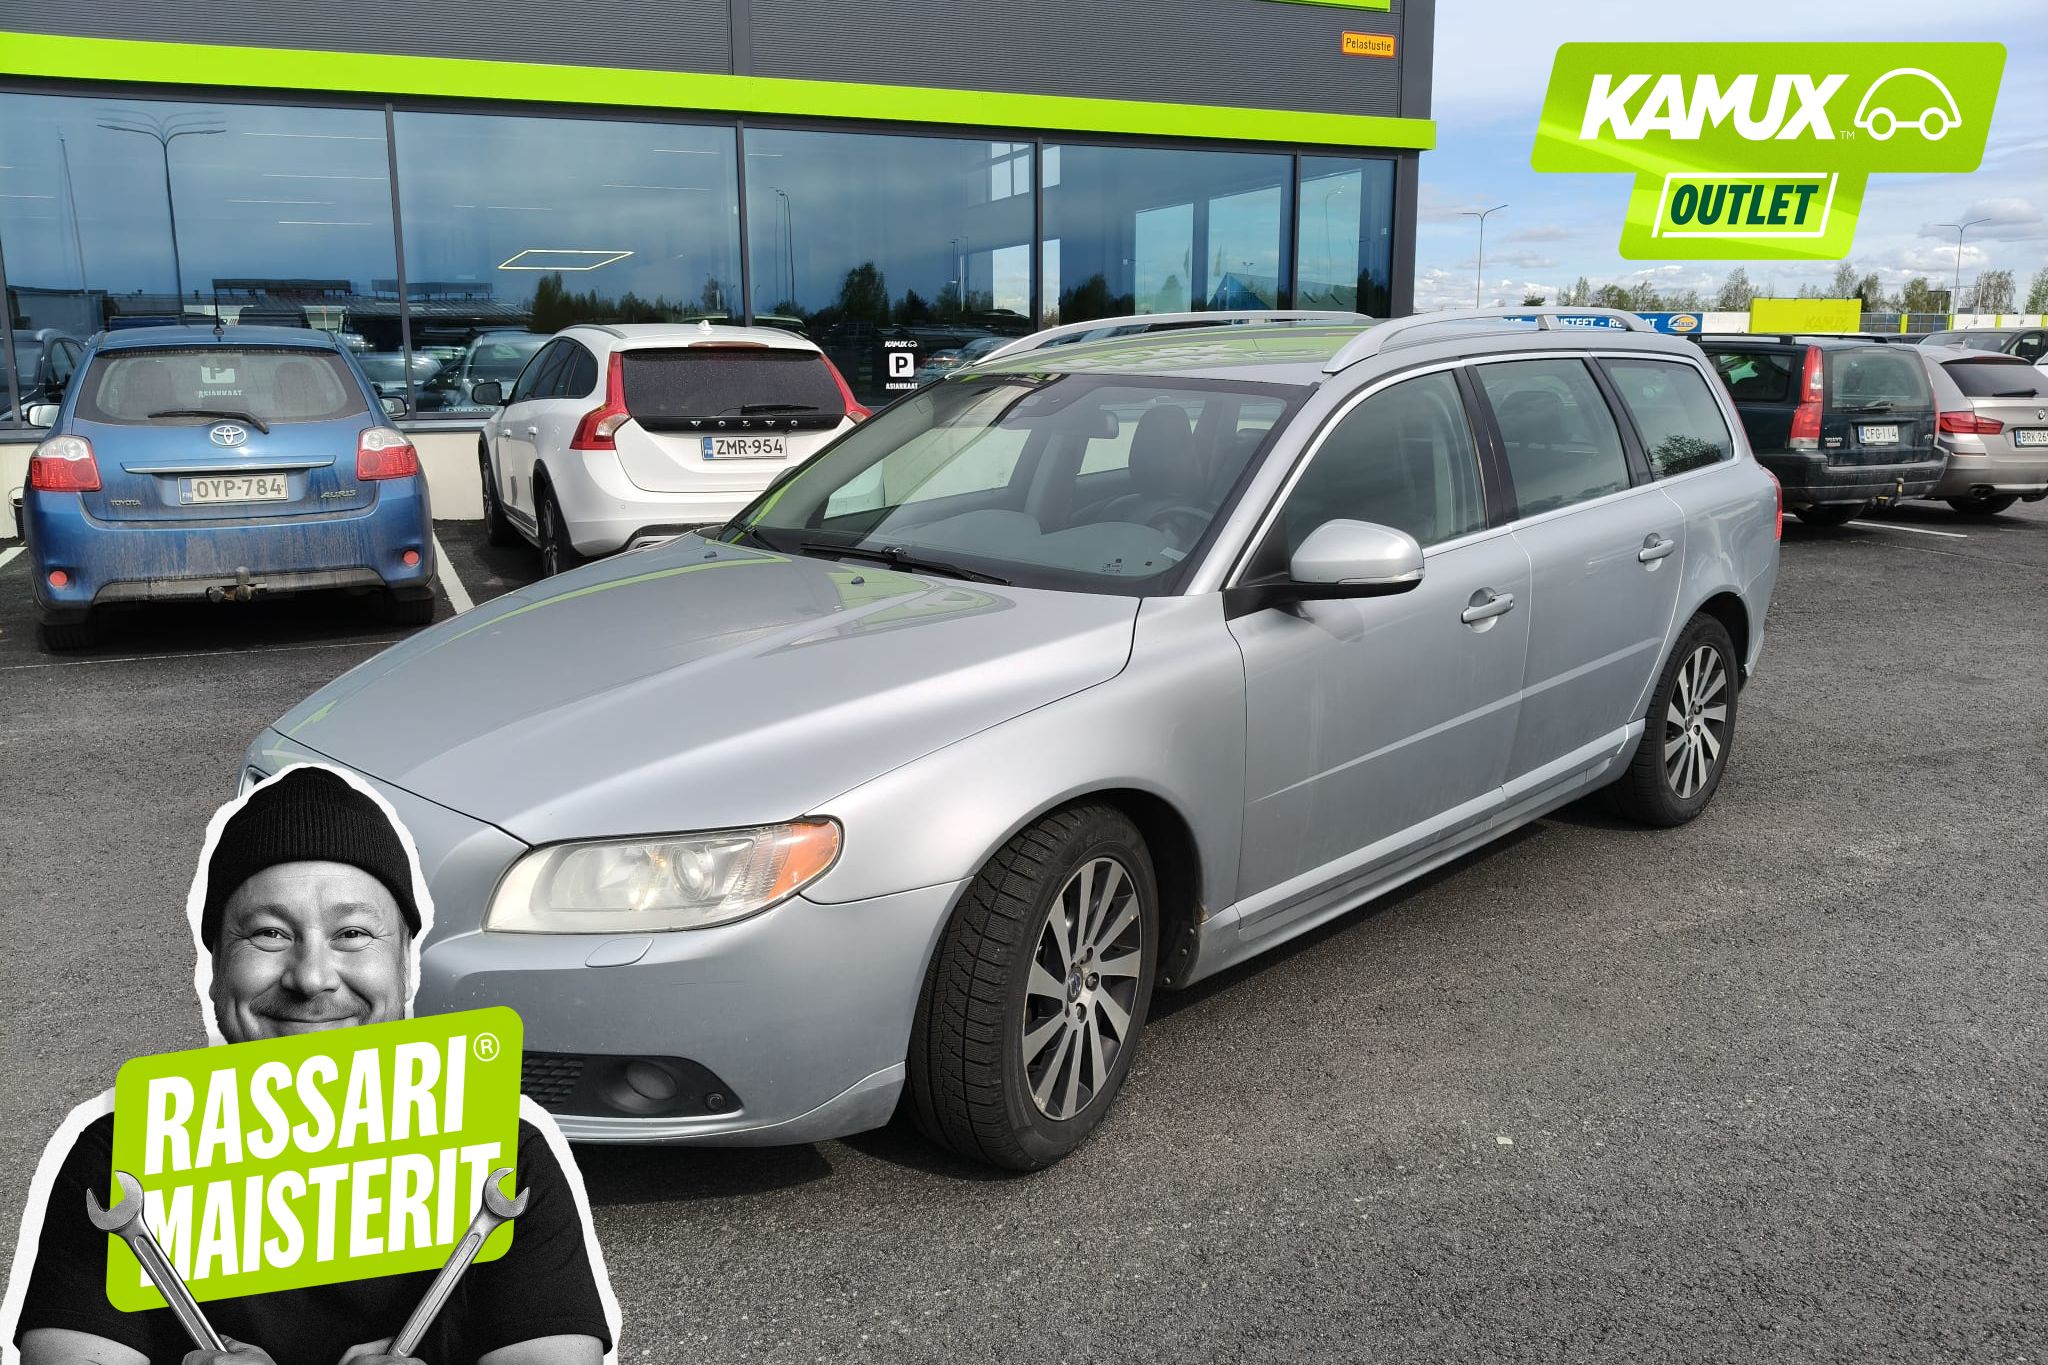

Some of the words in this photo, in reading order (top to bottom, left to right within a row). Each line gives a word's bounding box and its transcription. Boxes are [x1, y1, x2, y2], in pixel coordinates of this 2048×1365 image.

[1345, 37, 1392, 52] Pelastustie
[895, 356, 909, 374] P
[2021, 431, 2048, 443] BRK-26
[715, 438, 784, 455] ZMR-954
[195, 478, 283, 498] OYP-784
[319, 489, 357, 499] AURIS
